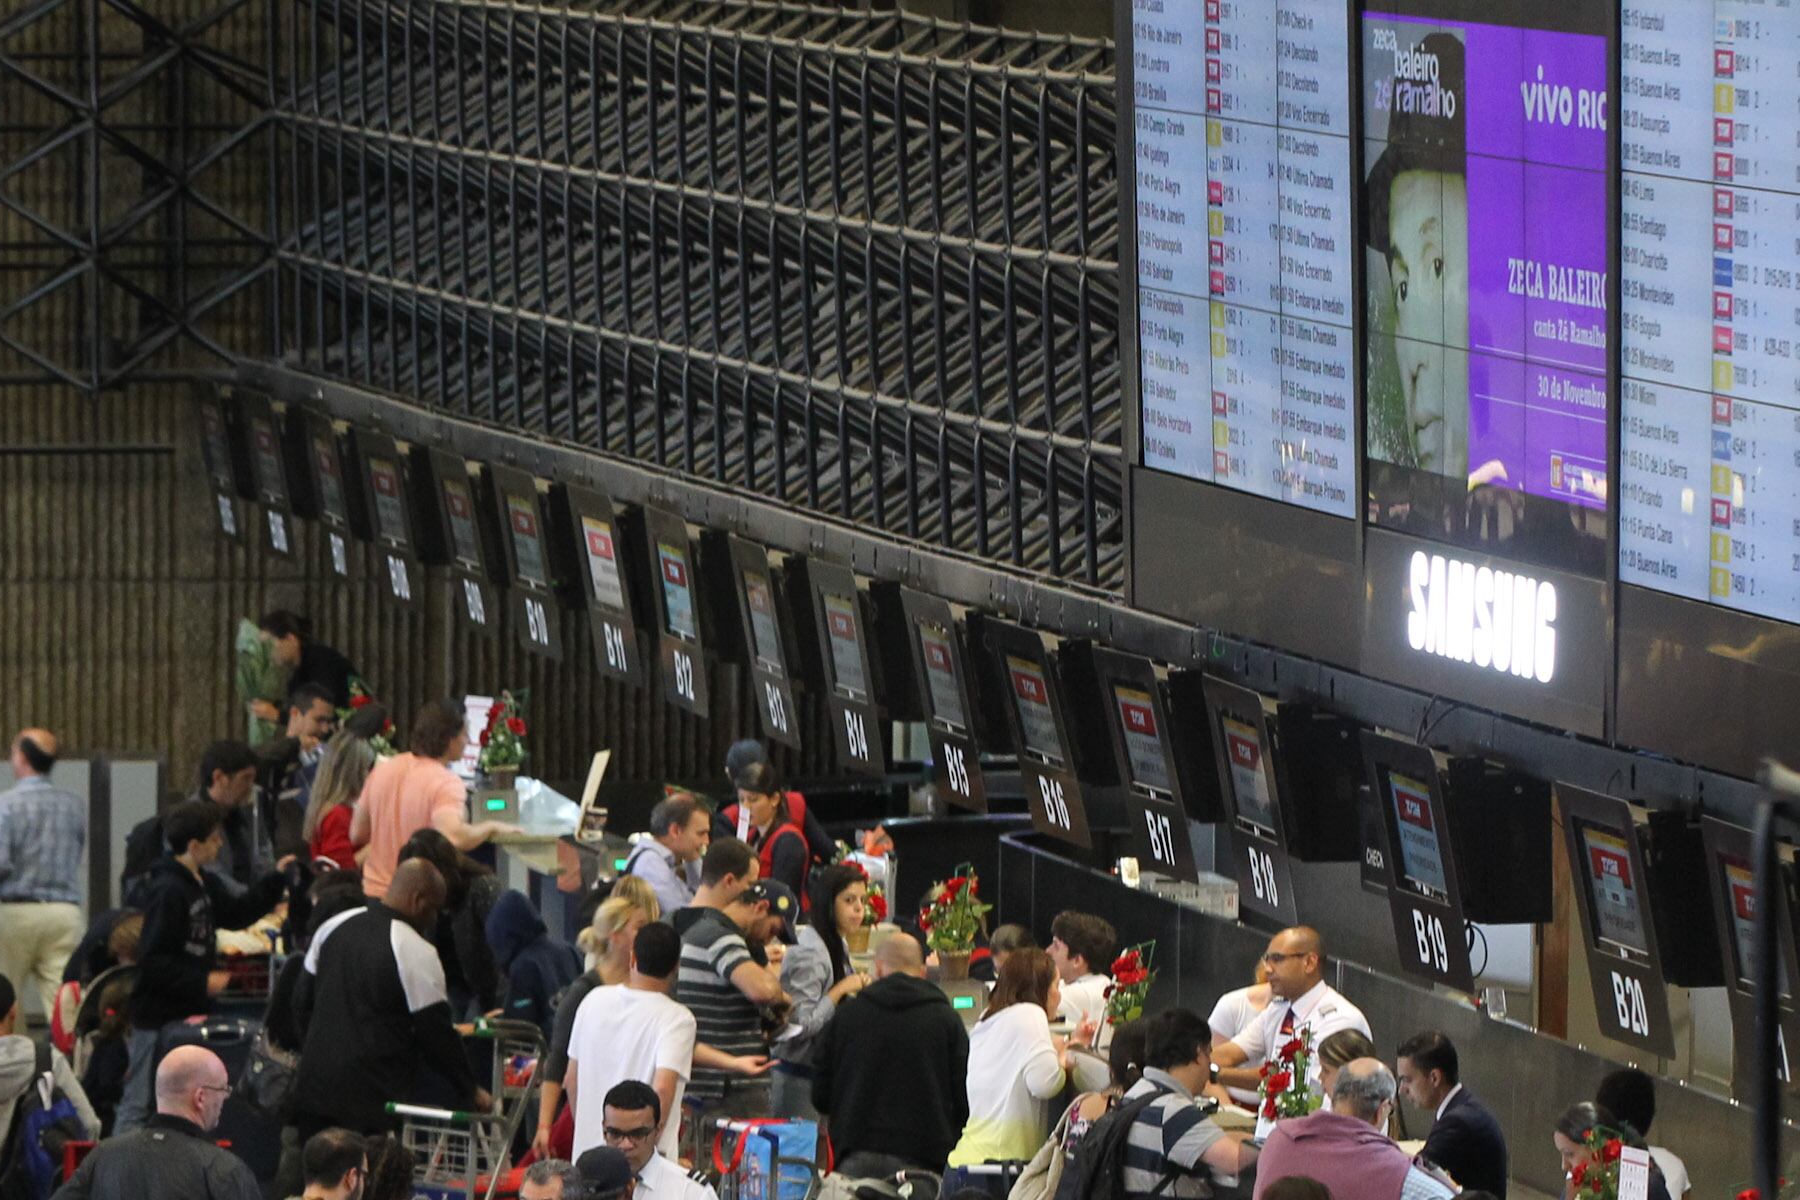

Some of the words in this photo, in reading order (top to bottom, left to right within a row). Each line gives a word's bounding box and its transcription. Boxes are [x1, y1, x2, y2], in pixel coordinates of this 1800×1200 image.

[1373, 28, 1395, 51] zeca
[1394, 43, 1439, 82] baleiro
[1395, 80, 1455, 119] ramalho
[1520, 64, 1573, 127] vivo
[1508, 258, 1544, 299] ZECA
[1534, 318, 1555, 339] canta
[1558, 320, 1568, 342] Zé
[1570, 321, 1606, 349] Ramalho
[1538, 375, 1549, 397] 30
[1551, 376, 1561, 399] de
[1563, 379, 1606, 409] Novembro
[1638, 553, 1660, 575] Buenos
[1661, 558, 1677, 579] Aires
[526, 598, 548, 646] B10
[1408, 551, 1556, 683] SAMSUNG
[604, 622, 627, 672] B11
[674, 650, 695, 701] B12
[765, 680, 787, 734] B13
[844, 709, 869, 762] B14
[944, 742, 970, 797] B15
[1038, 774, 1070, 831] B16
[1144, 809, 1175, 866] B17
[1366, 847, 1384, 869] CHECK
[1248, 847, 1278, 907] B18
[1412, 909, 1448, 973] B19
[1611, 971, 1648, 1037] B20
